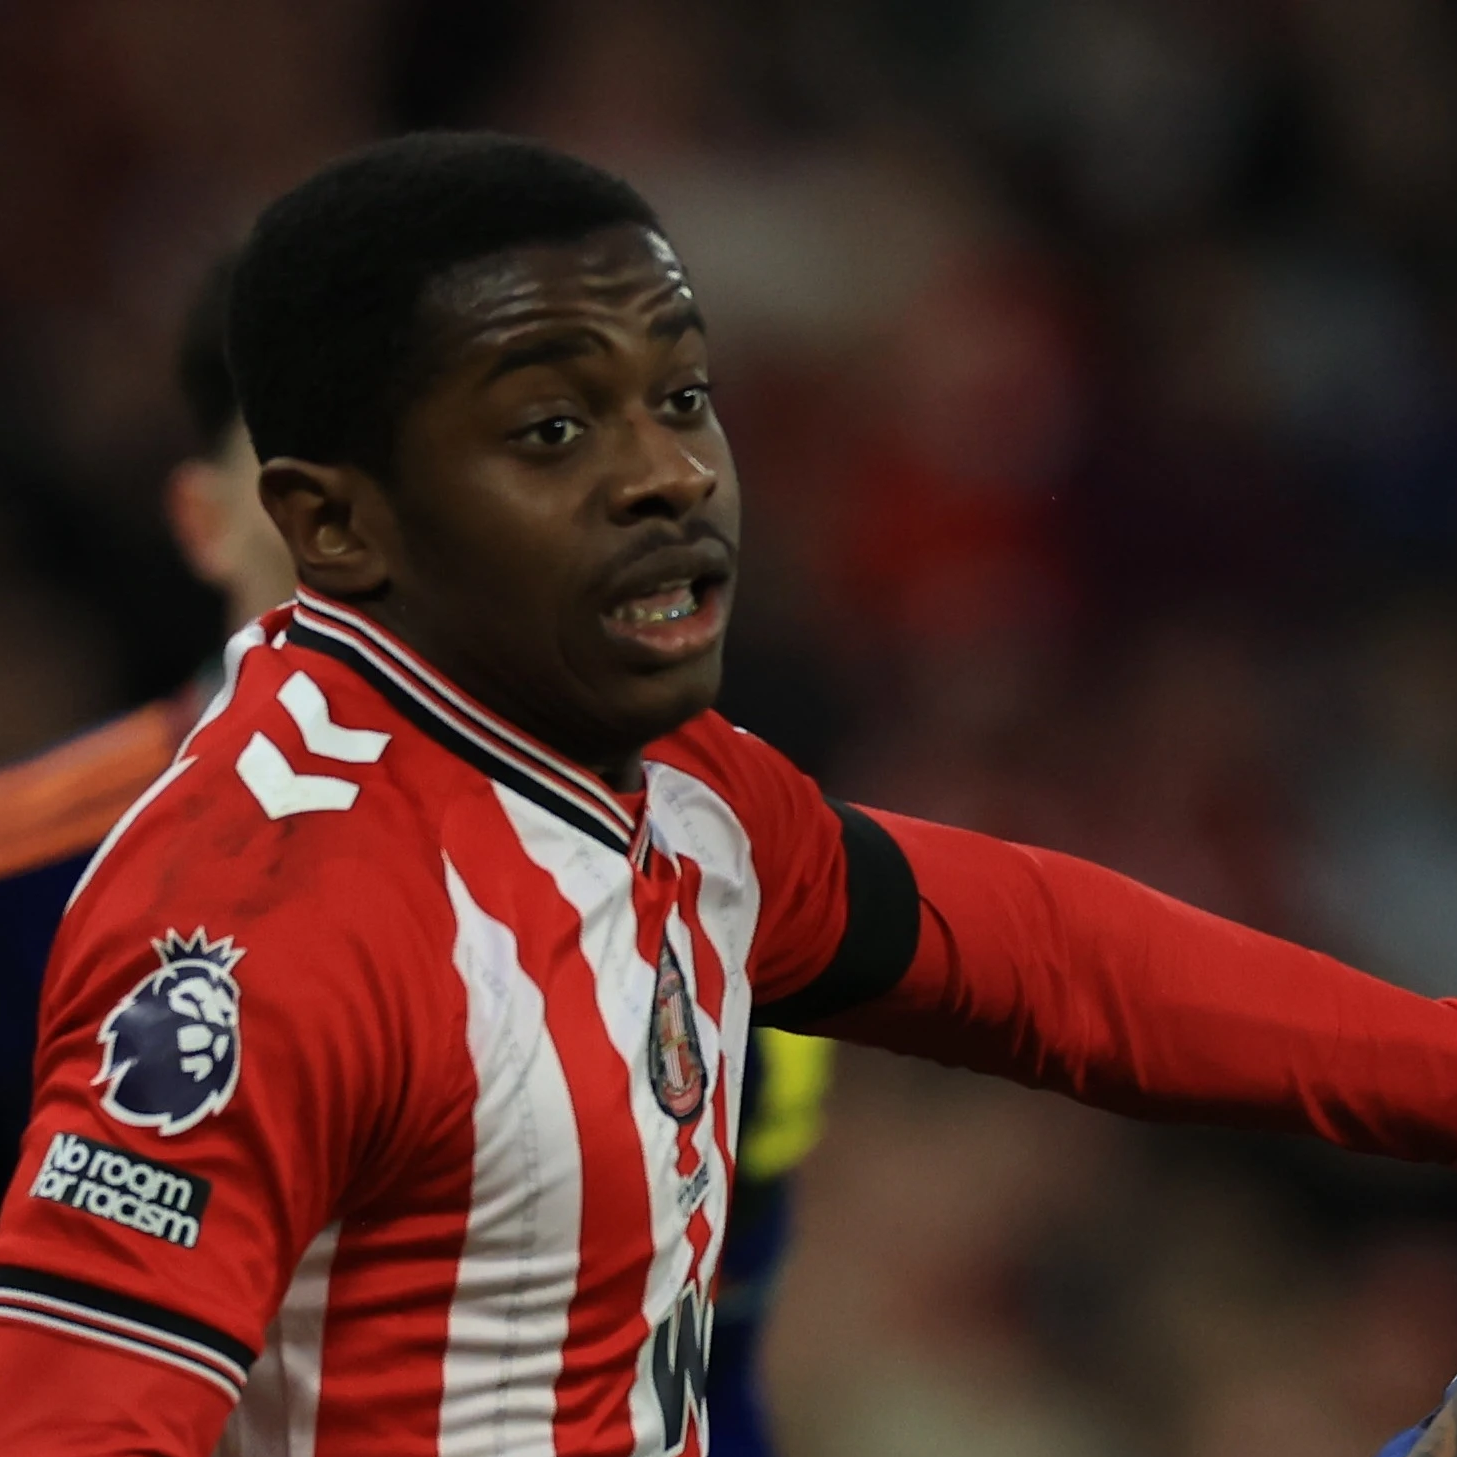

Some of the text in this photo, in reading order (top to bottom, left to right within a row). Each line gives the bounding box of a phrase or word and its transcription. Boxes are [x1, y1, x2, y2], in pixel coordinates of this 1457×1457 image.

[45, 1132, 193, 1212] No room
[71, 1178, 200, 1249] racism
